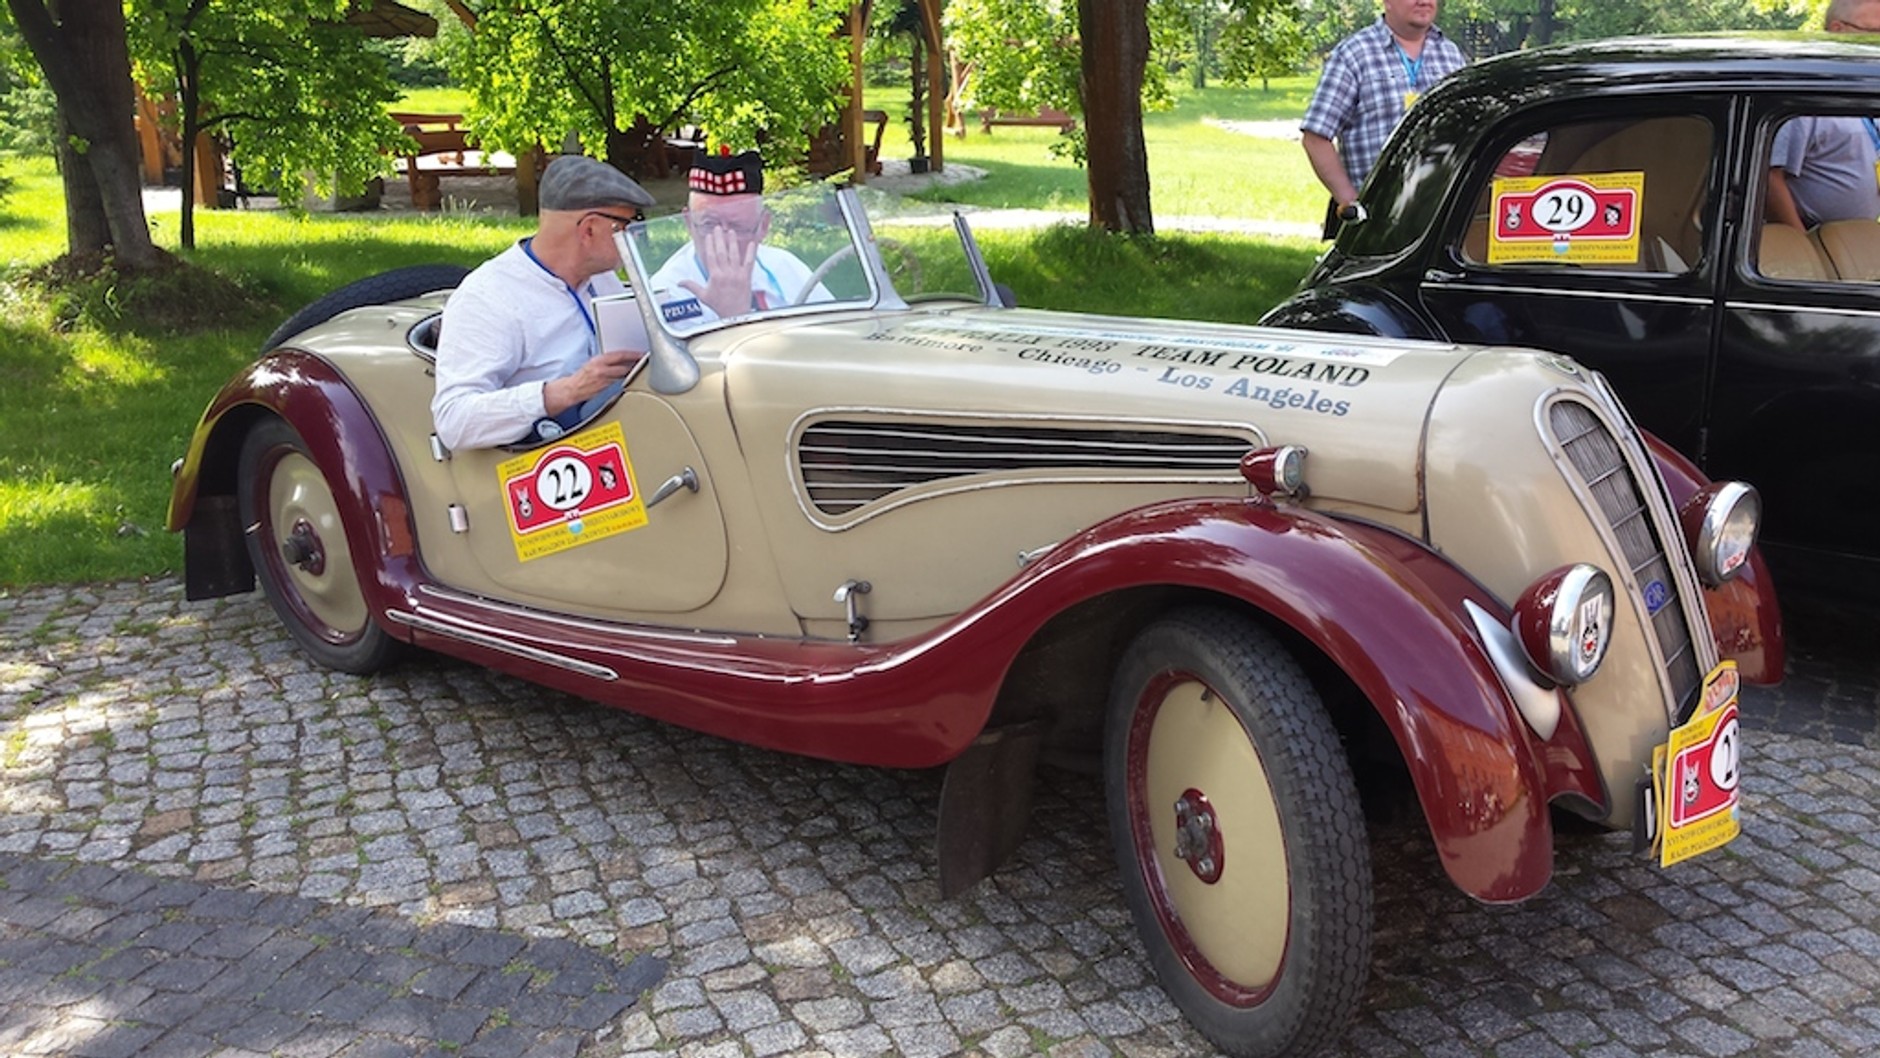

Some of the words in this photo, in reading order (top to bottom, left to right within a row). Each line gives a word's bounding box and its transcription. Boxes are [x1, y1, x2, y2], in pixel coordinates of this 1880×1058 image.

[1547, 195, 1584, 225] 29
[1017, 347, 1122, 375] Chicago
[1157, 366, 1214, 389] Los
[1223, 377, 1352, 416] Angeles
[1056, 336, 1118, 353] 1993
[1132, 345, 1230, 367] TEAM
[1229, 353, 1371, 388] POLAND
[548, 463, 583, 505] 22
